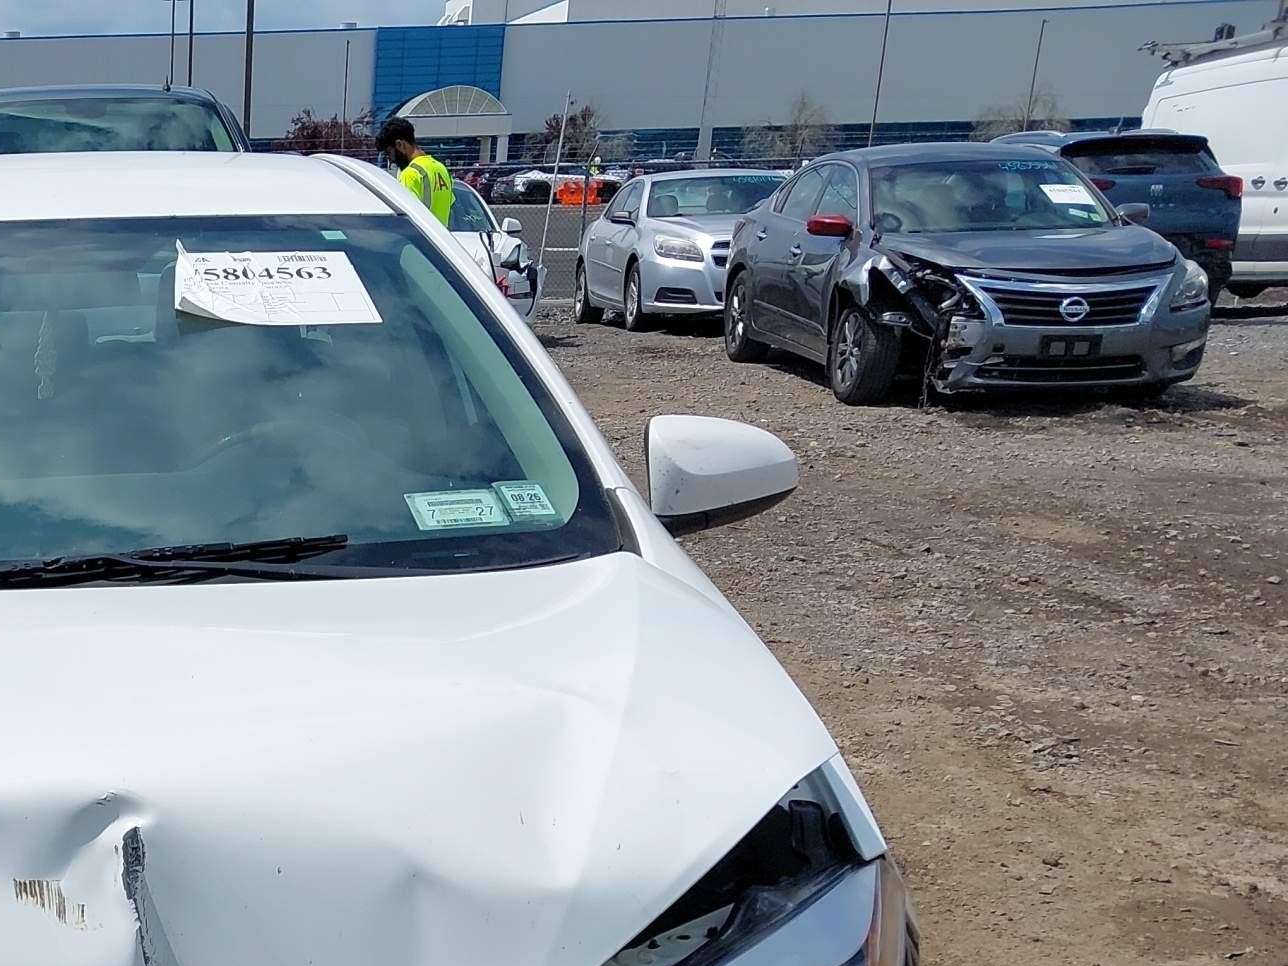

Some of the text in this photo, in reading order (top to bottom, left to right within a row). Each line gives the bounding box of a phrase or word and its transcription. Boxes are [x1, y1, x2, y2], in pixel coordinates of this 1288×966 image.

[510, 492, 542, 502] 08 26
[427, 509, 436, 520] 7
[475, 505, 495, 516] 27
